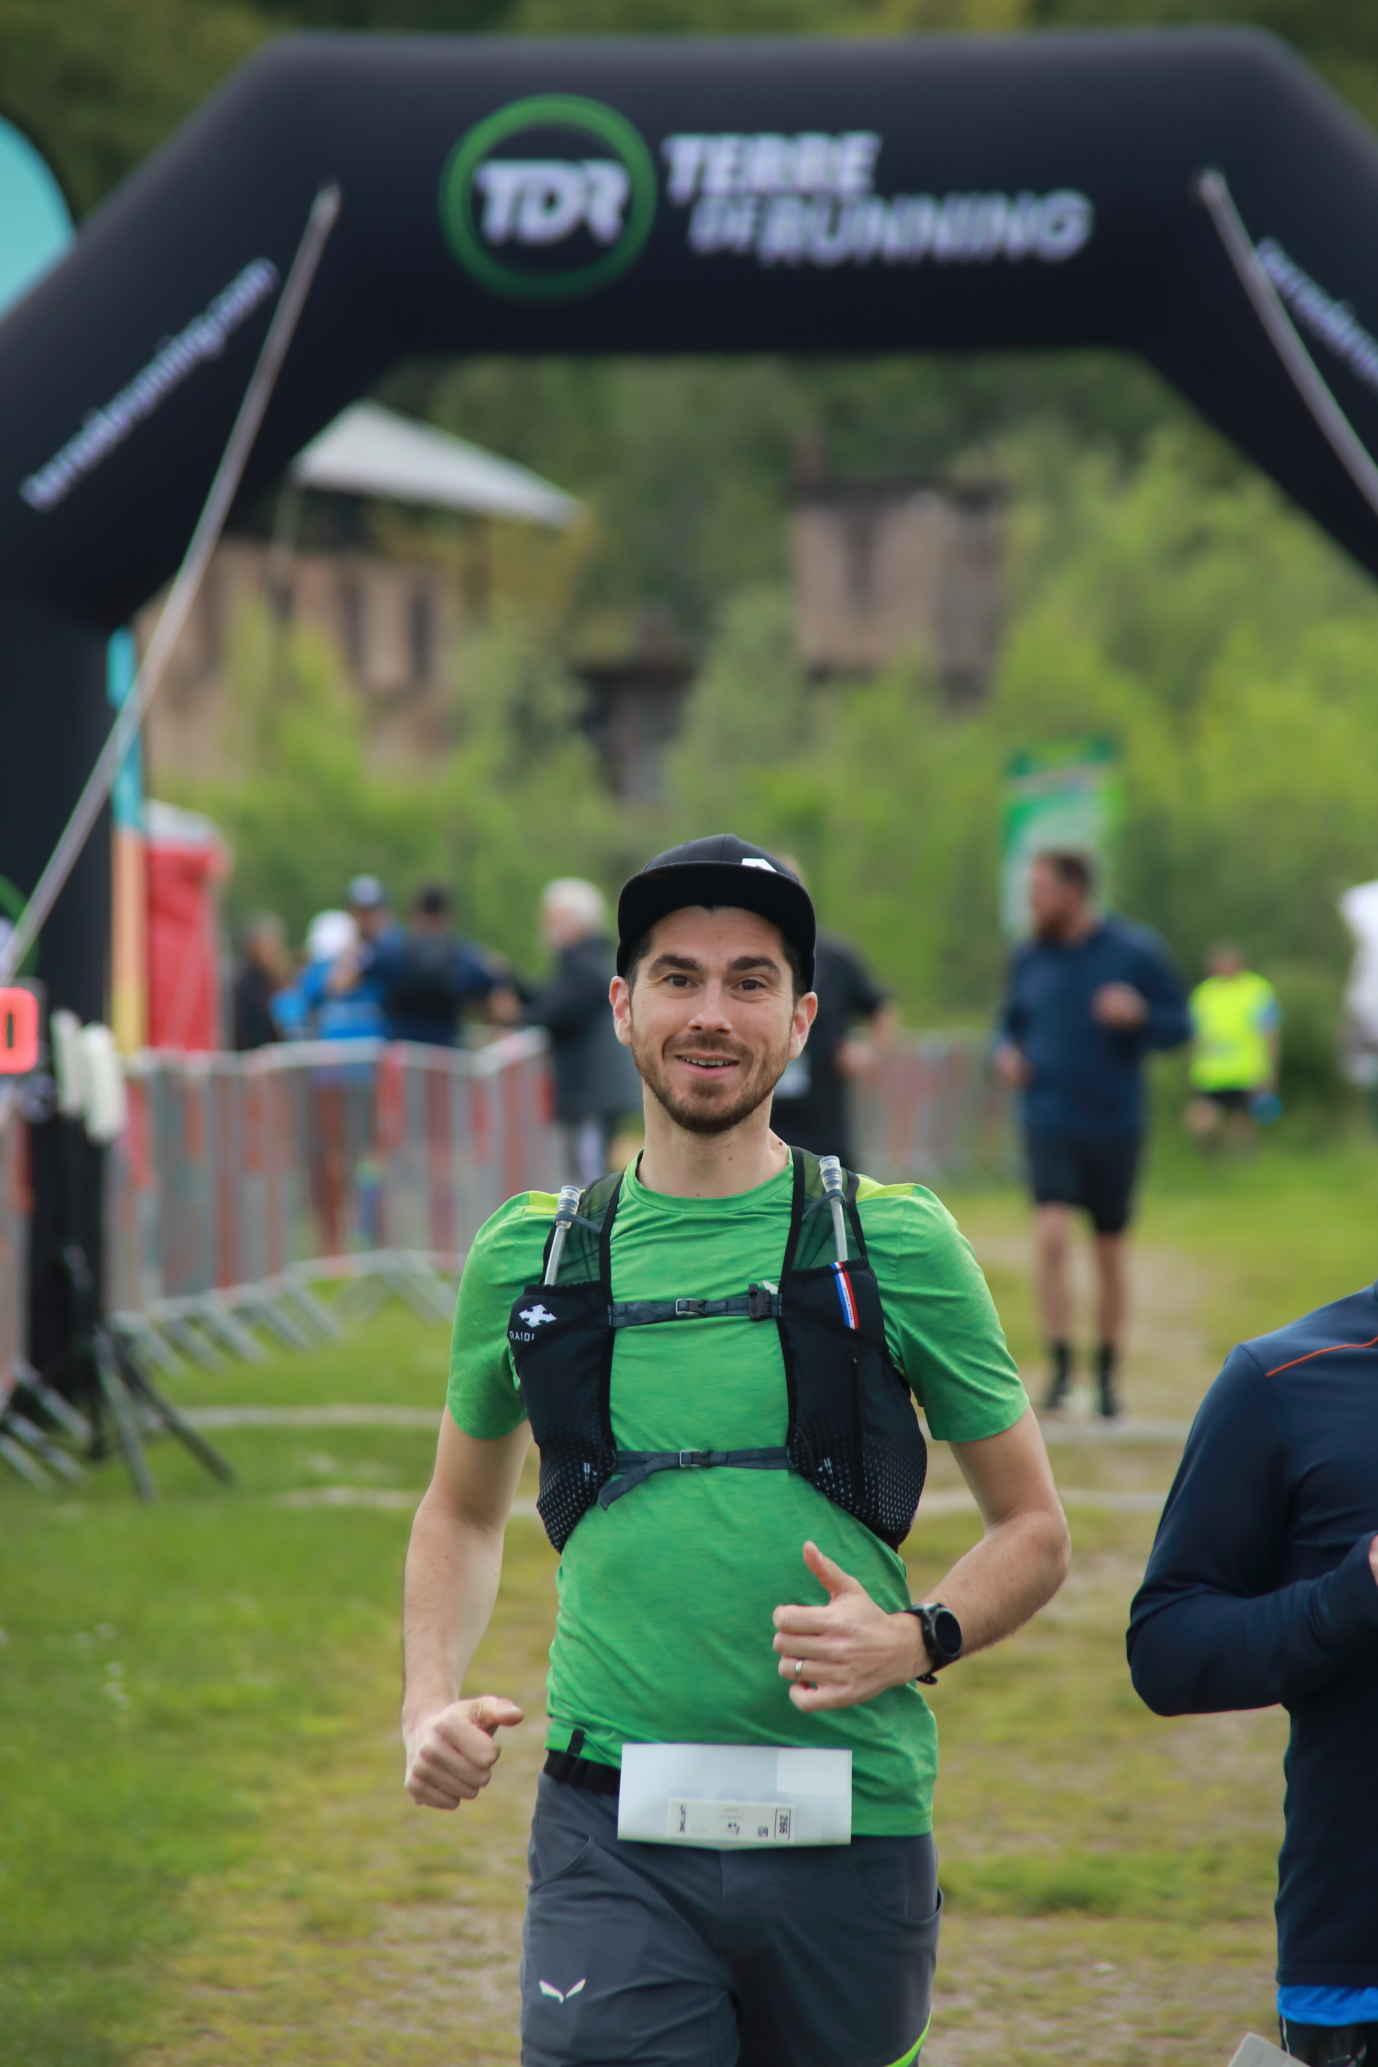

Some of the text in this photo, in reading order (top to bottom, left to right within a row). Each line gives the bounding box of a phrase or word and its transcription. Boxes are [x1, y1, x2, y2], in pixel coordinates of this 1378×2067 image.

[474, 159, 631, 244] TDR
[662, 132, 881, 204] TERRE
[758, 190, 1092, 265] RUNNING
